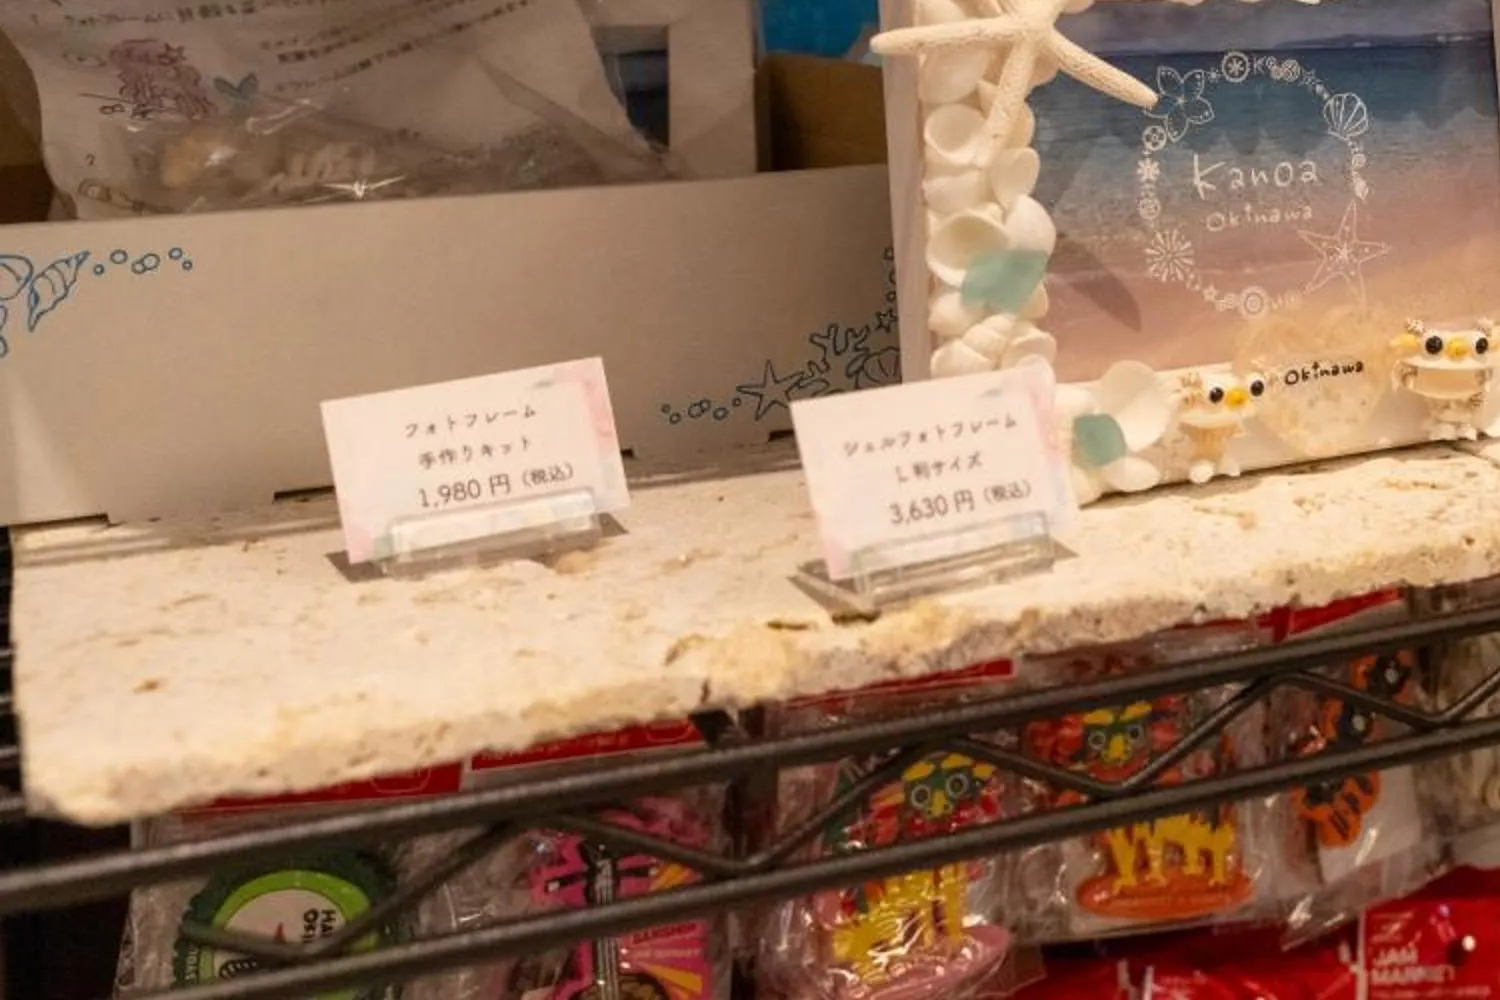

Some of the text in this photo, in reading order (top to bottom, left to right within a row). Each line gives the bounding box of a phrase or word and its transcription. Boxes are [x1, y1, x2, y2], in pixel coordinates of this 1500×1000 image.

[1206, 204, 1313, 231] Okinawa
[1285, 361, 1363, 385] Okinawa
[405, 405, 536, 438] フォトフレーム
[419, 436, 531, 470] 手作りキット
